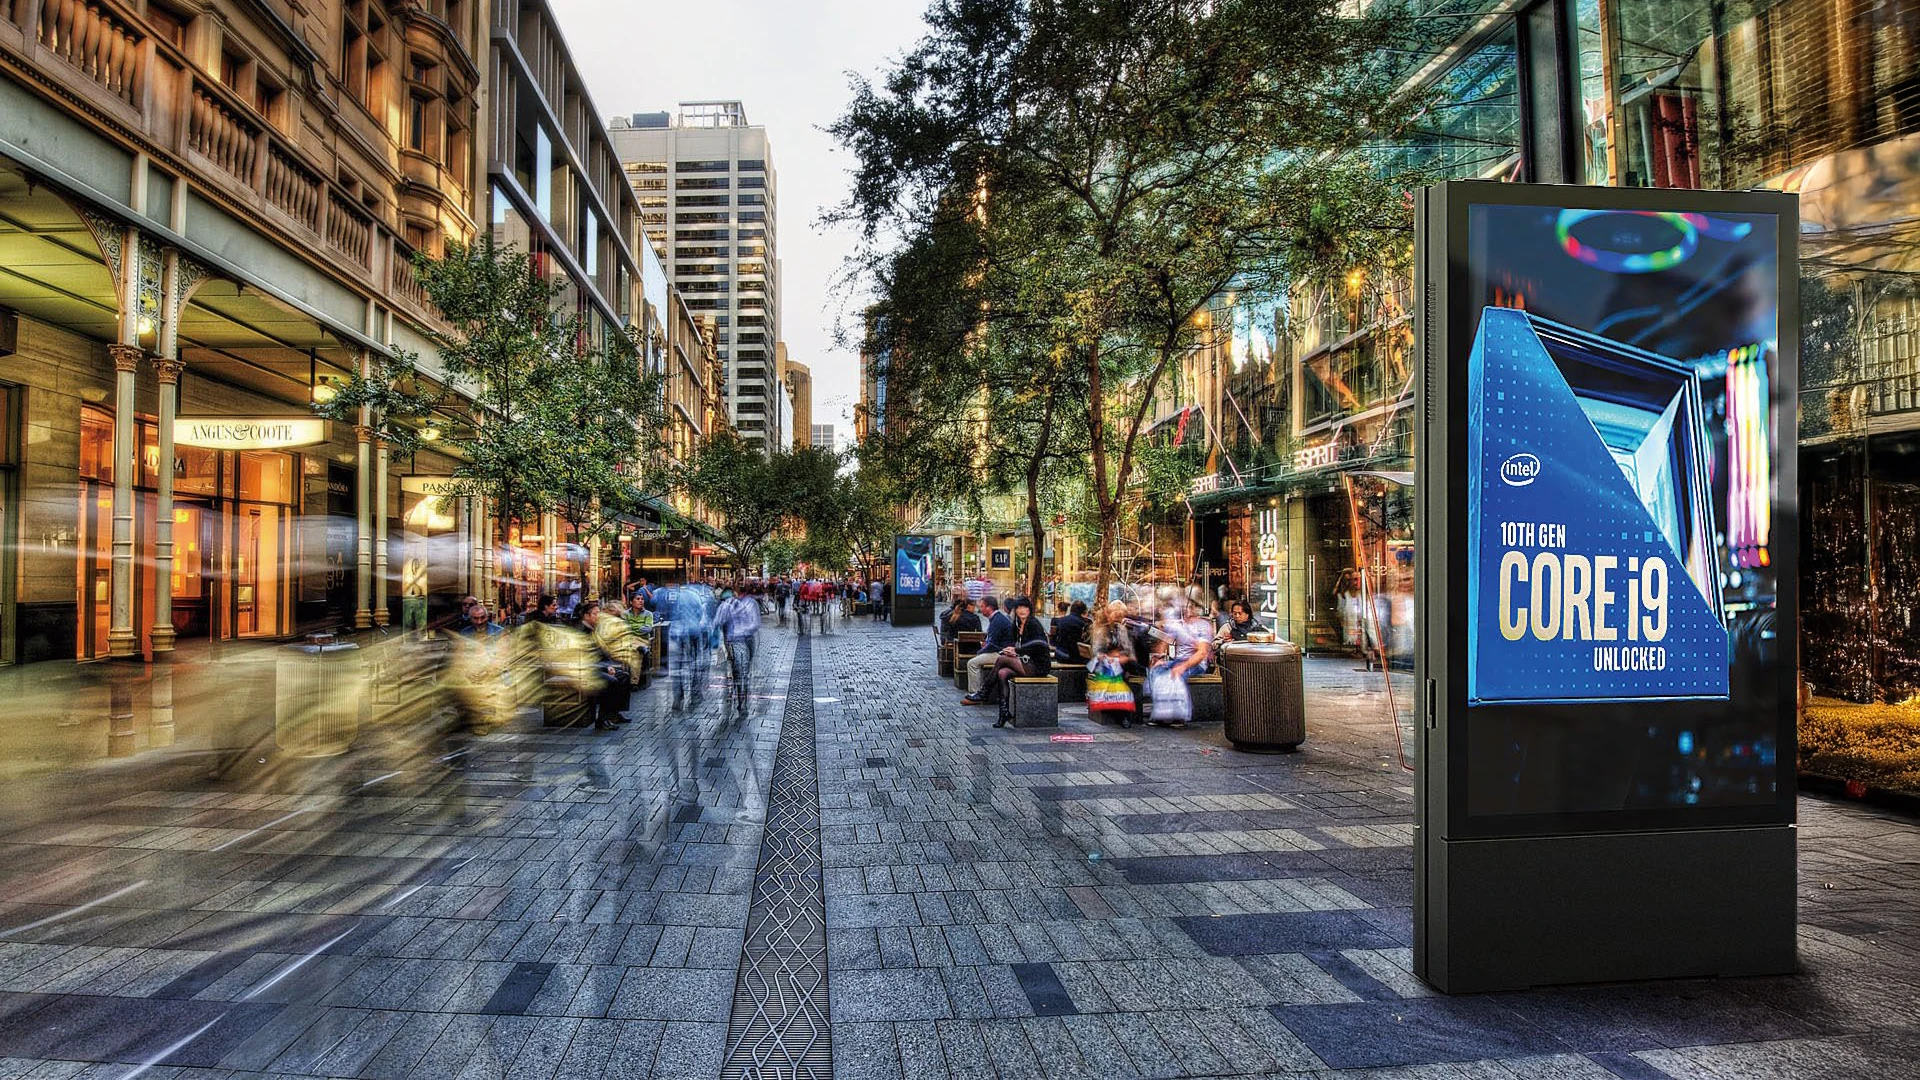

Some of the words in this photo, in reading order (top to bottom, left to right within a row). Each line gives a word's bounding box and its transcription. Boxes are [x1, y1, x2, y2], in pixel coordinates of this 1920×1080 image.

[191, 424, 293, 440] ANGUS&COOTE
[1294, 443, 1338, 471] ESPRIT
[1505, 459, 1535, 477] intel
[1191, 473, 1218, 494] ESPRIT
[1500, 522, 1535, 547] 10TH
[1538, 524, 1566, 548] GEN
[995, 554, 1008, 564] GAP
[1499, 551, 1618, 641] CORE
[1628, 556, 1668, 642] i9
[1594, 647, 1666, 671] UNLOCKED
